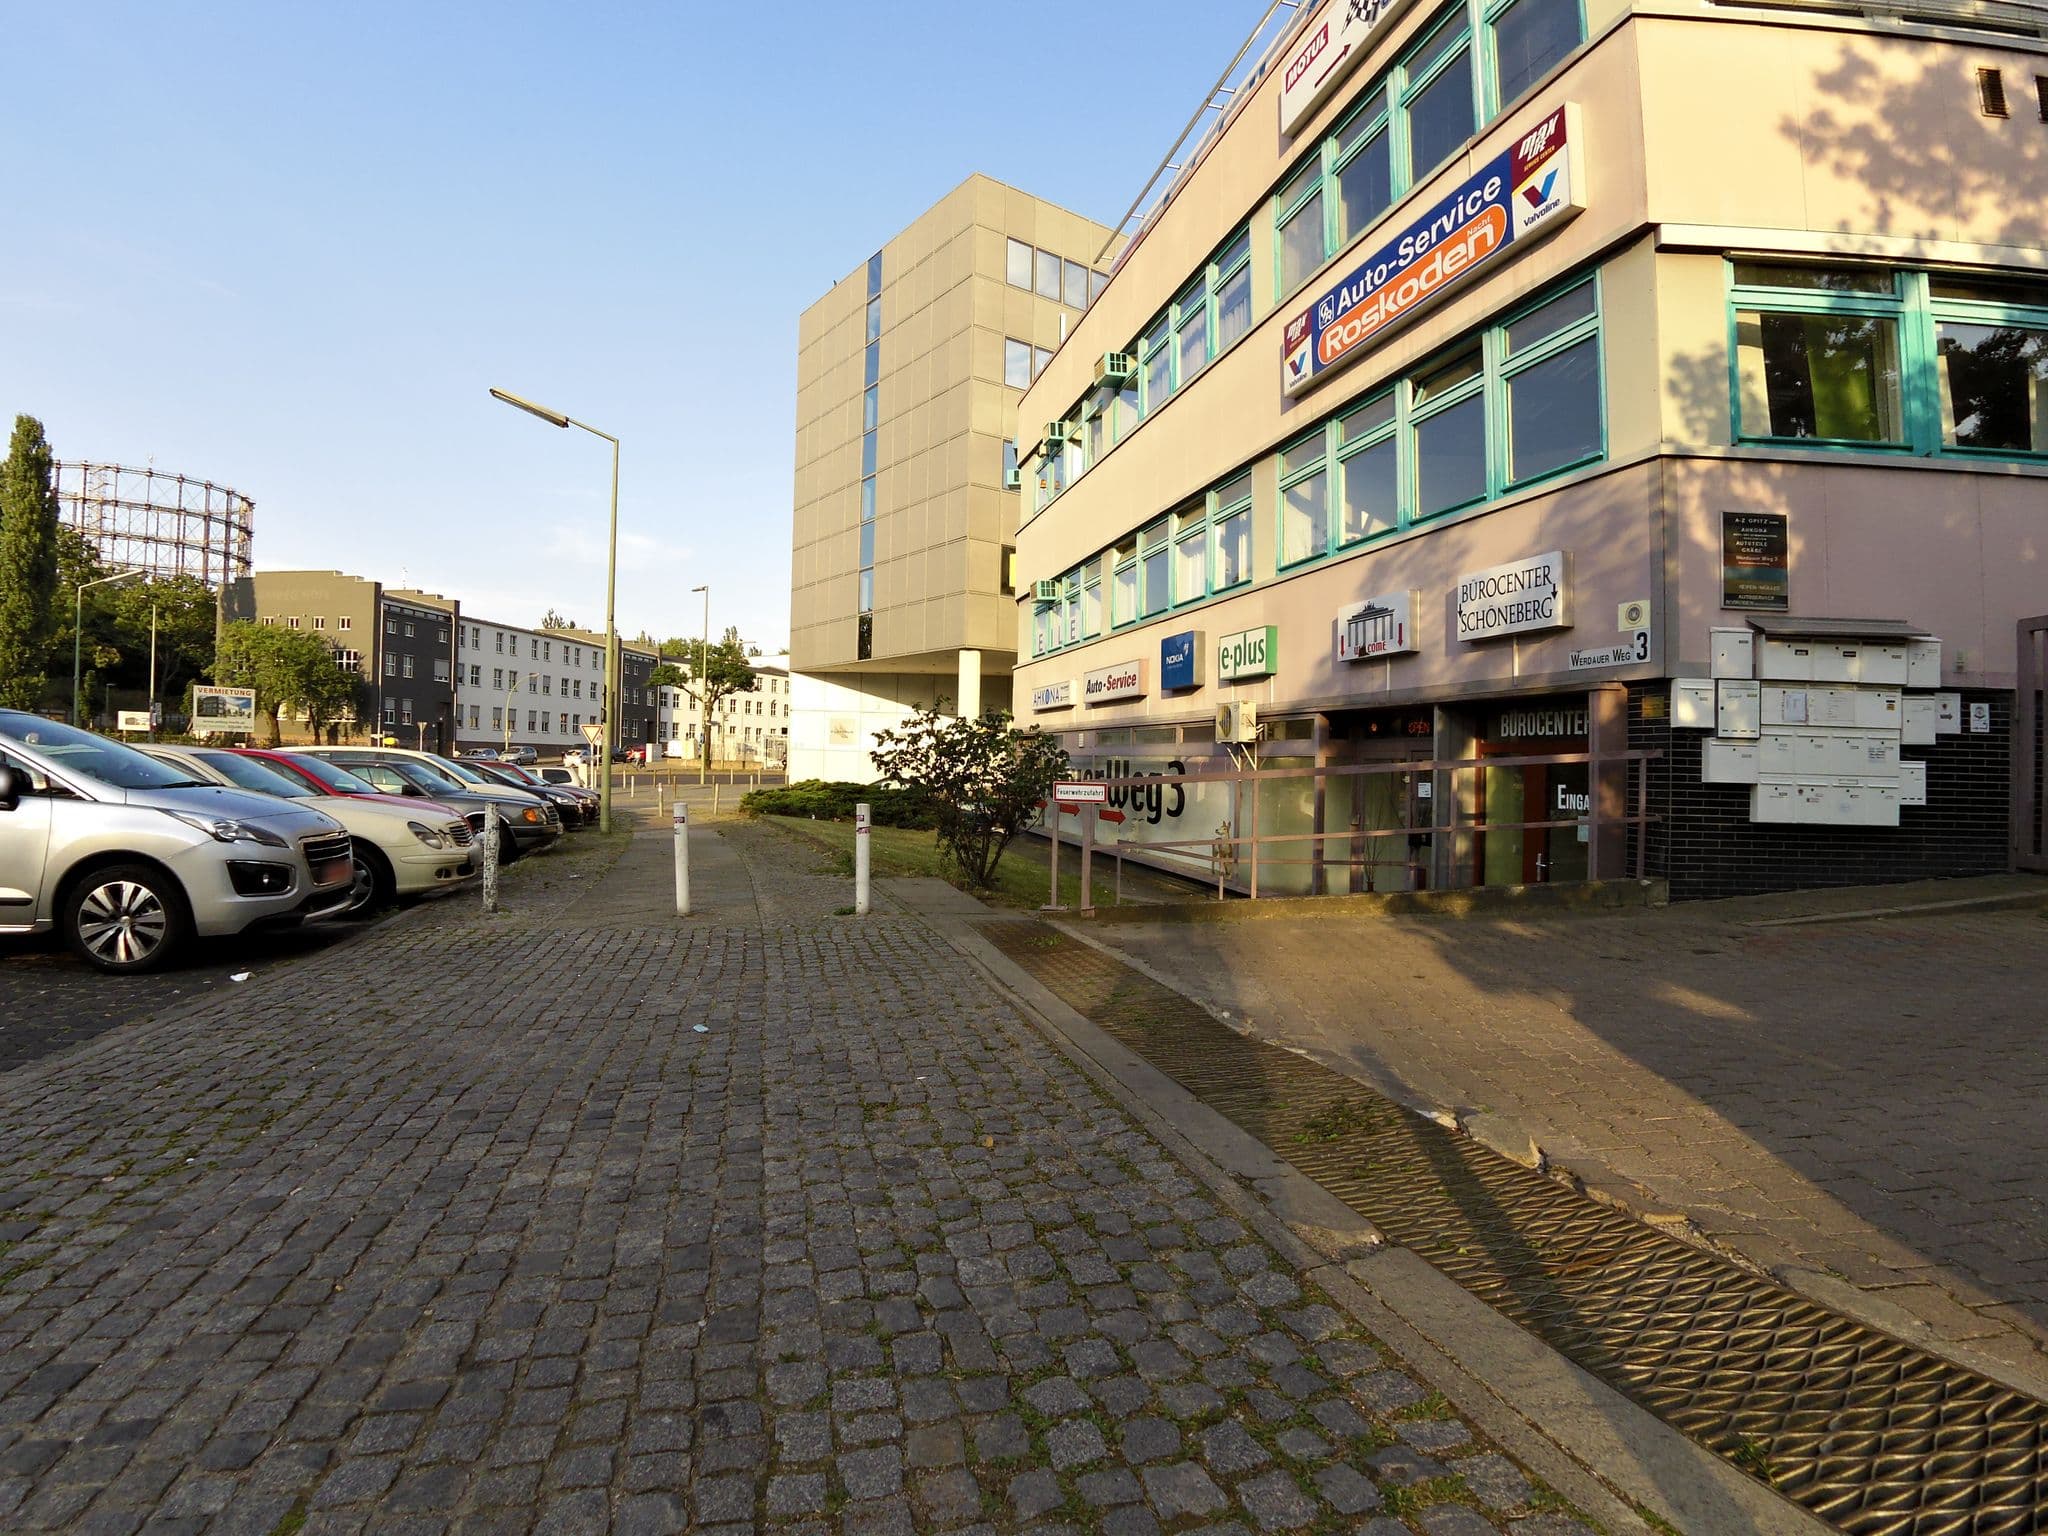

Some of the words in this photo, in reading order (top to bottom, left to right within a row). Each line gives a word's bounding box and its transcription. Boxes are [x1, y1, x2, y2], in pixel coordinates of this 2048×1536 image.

[1287, 29, 1328, 88] MOTUL
[1524, 199, 1561, 227] Valvoline
[1337, 176, 1501, 315] Auto-Service
[1326, 223, 1495, 357] Roskoden
[1462, 565, 1553, 603] BÜROCENTER
[1461, 598, 1553, 632] SCHÖNEBERG
[1166, 653, 1183, 665] NOKIA
[1637, 632, 1648, 661] 3
[198, 687, 252, 697] VERMIETUNG
[1167, 760, 1186, 817] 3
